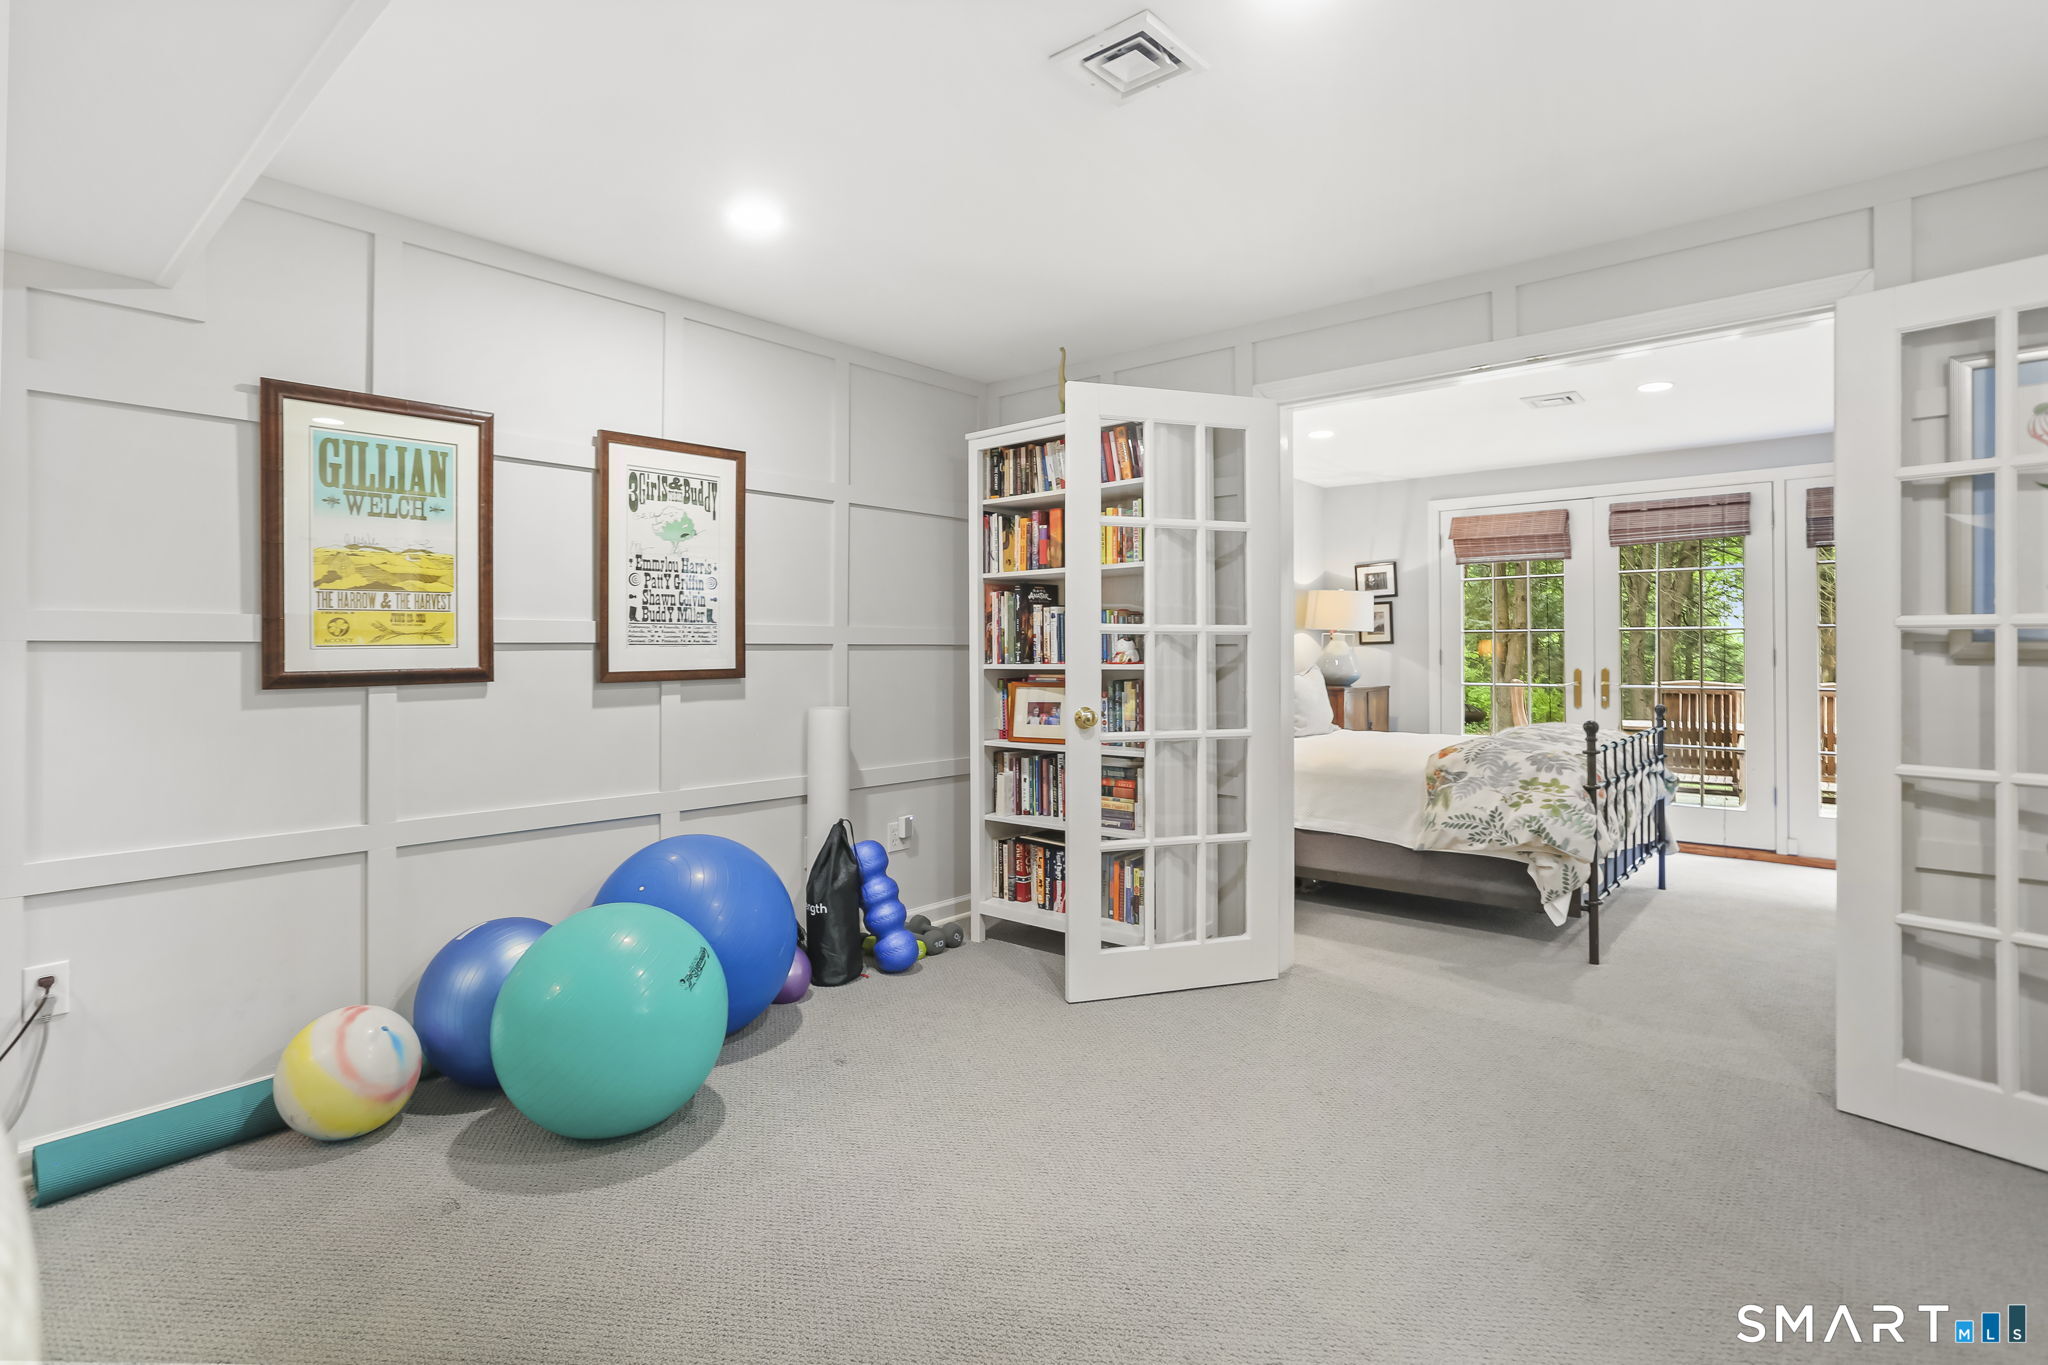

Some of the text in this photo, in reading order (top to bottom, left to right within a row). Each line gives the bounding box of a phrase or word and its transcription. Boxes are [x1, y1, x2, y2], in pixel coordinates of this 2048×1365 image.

[318, 437, 449, 498] GILLIAN
[343, 490, 427, 521] WELCH
[635, 554, 712, 575] Emmylou Harris
[673, 574, 704, 591] Griffin
[316, 591, 452, 610] THE HARROW & THE HARVEST
[642, 589, 706, 607] Shawn Colvin
[677, 606, 705, 623] Miller
